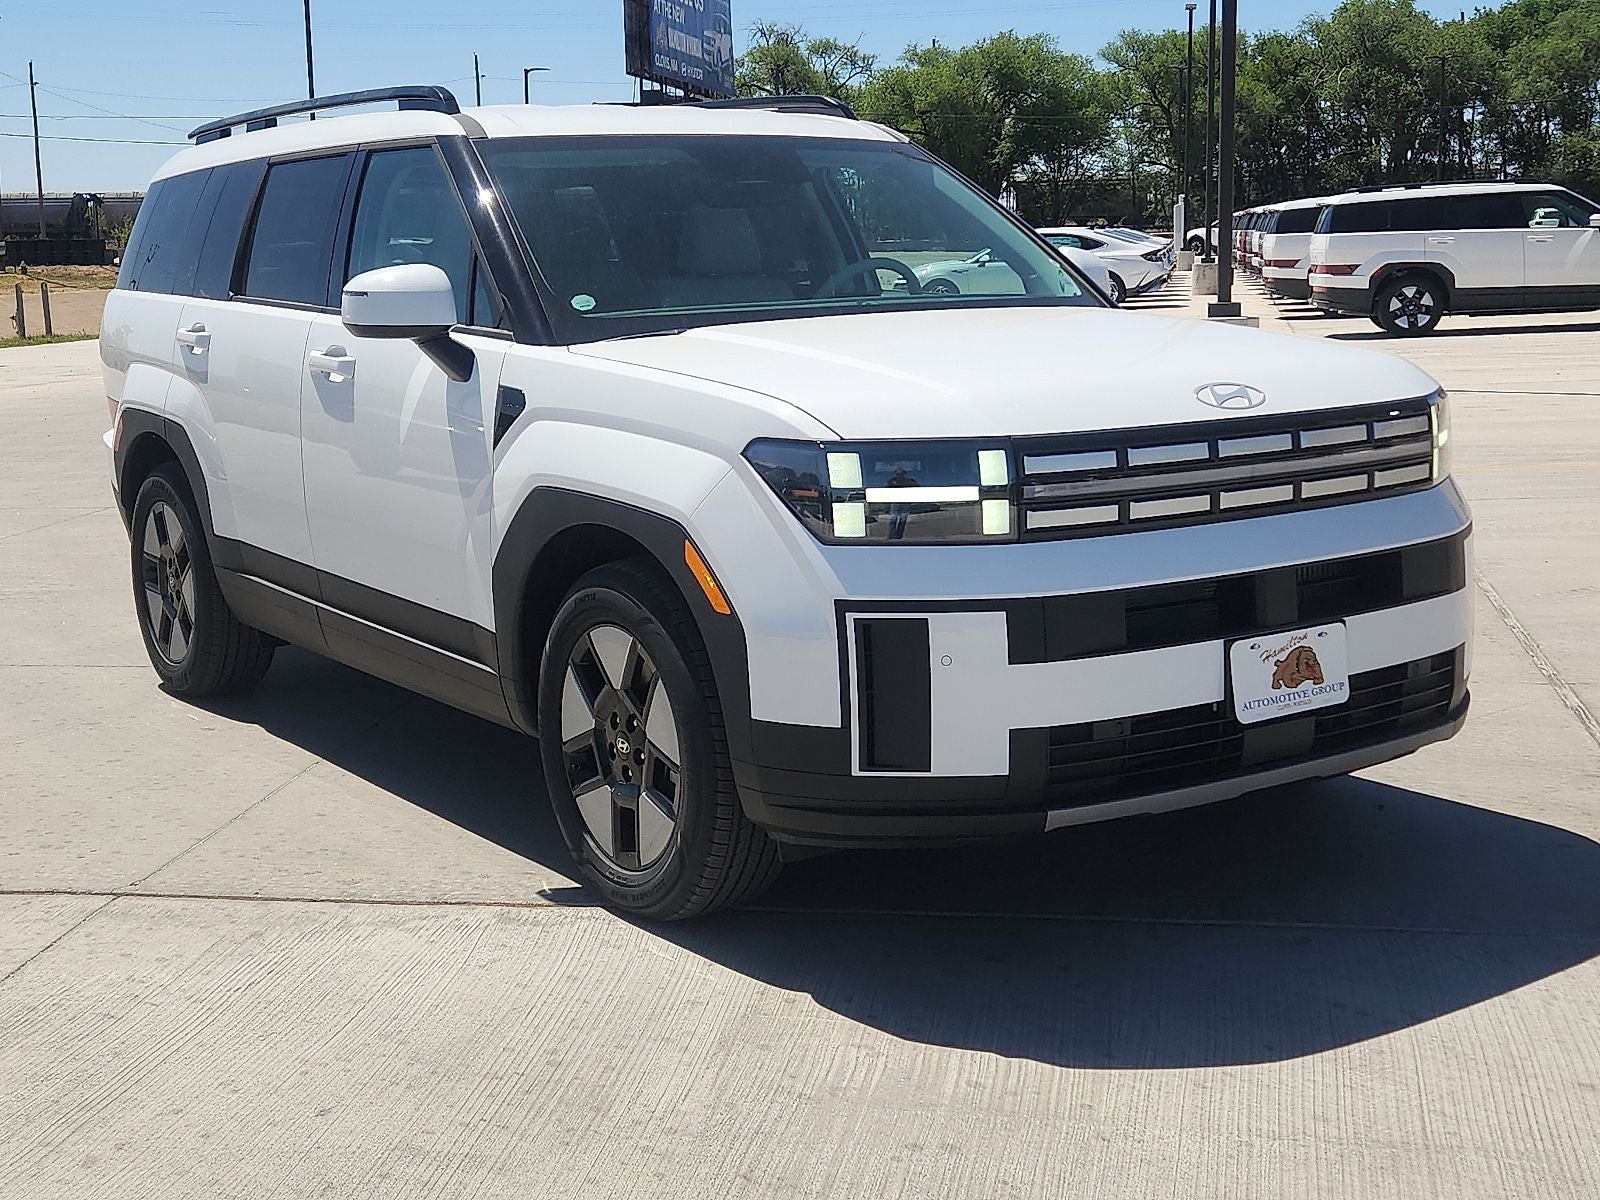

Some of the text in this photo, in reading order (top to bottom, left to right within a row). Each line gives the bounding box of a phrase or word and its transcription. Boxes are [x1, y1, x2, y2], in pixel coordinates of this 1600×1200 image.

[1259, 632, 1309, 664] Hamilton
[1242, 689, 1309, 712] AUTOMOTIVE
[1311, 682, 1345, 698] GROUP
